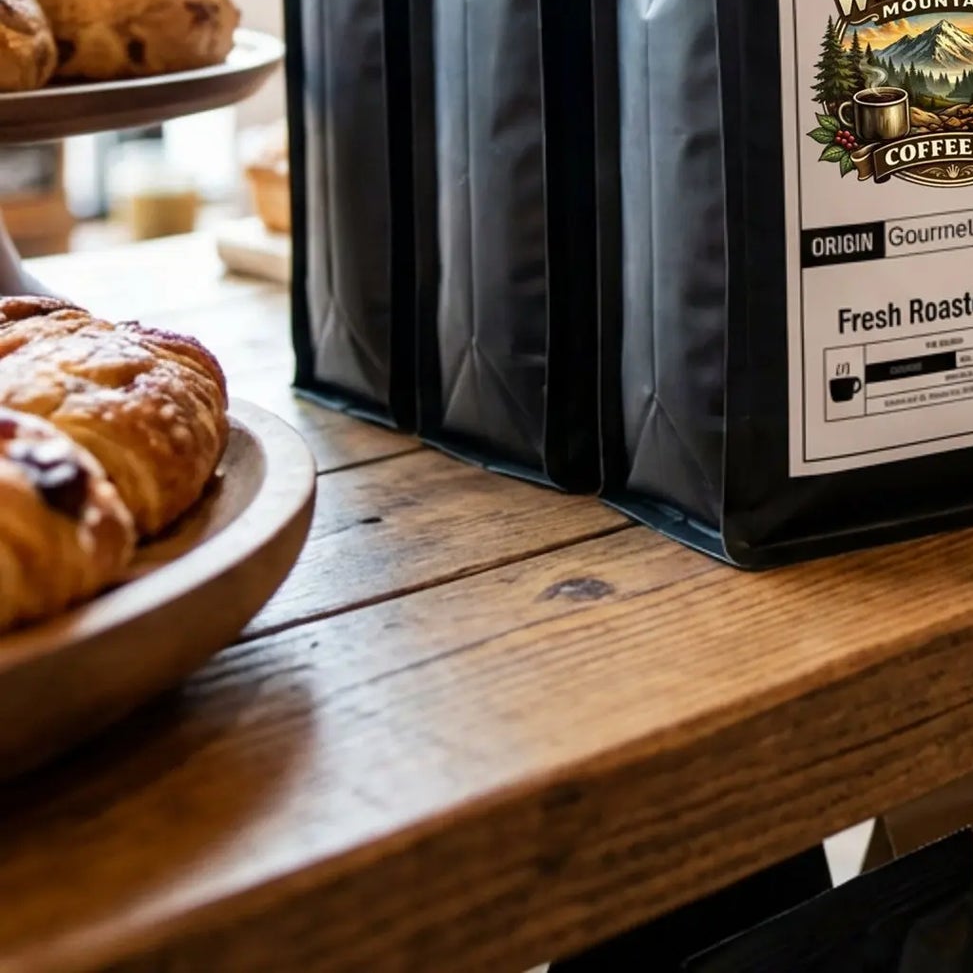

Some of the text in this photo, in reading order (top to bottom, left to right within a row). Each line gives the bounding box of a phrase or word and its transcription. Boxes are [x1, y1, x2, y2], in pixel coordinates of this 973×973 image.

[884, 137, 973, 166] COFFEE
[811, 231, 874, 258] ORIGIN
[888, 218, 973, 247] Gourmet
[838, 301, 902, 335] Fresh
